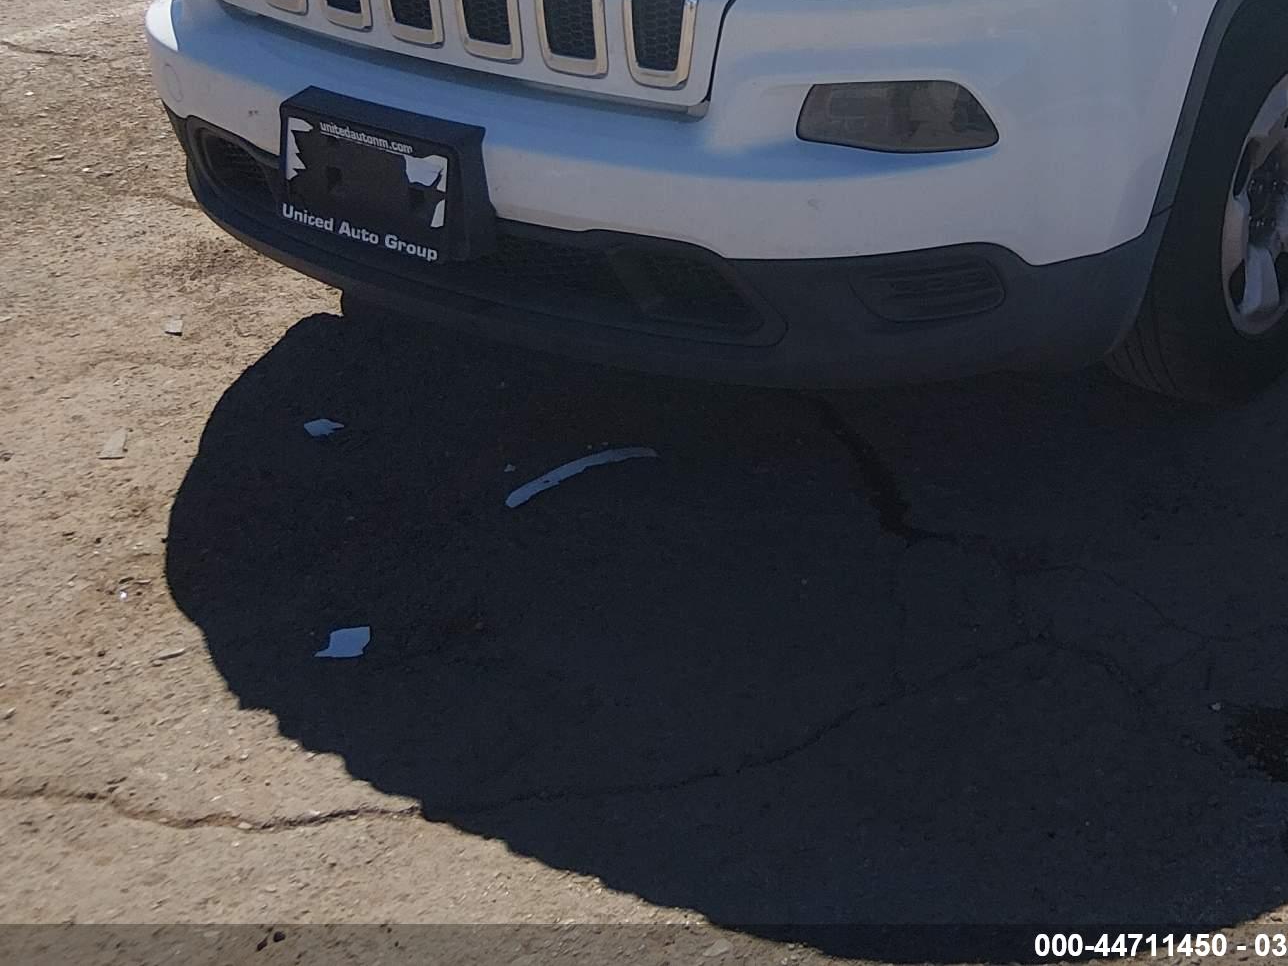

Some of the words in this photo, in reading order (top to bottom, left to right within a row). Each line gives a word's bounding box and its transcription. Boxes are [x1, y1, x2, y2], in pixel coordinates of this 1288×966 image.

[319, 121, 413, 154] unitedautonm.com
[338, 221, 379, 245] Auto
[384, 234, 438, 261] Group
